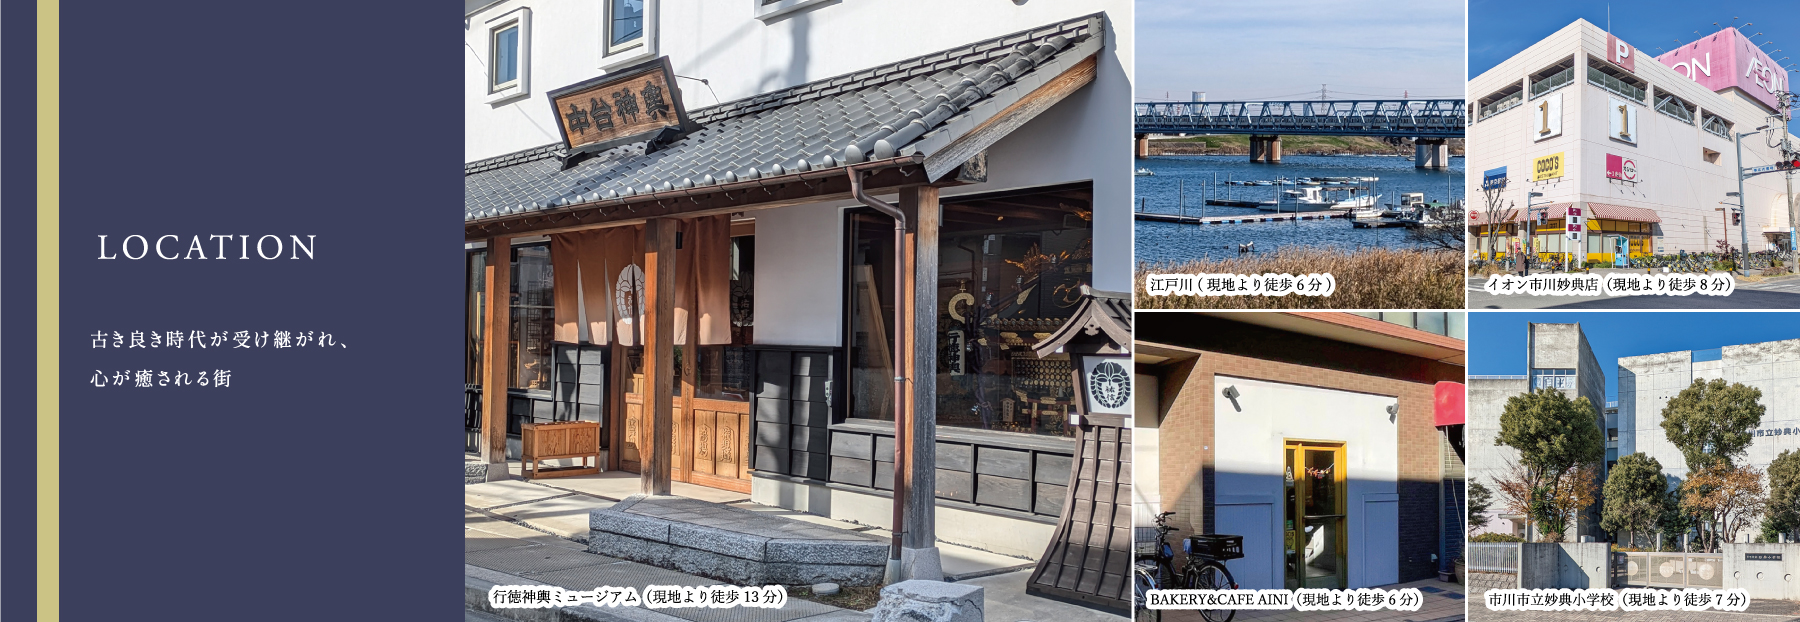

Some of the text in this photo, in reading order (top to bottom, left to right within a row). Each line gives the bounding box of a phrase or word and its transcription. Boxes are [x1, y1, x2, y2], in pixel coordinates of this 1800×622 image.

[1615, 39, 1629, 63] P
[1671, 52, 1711, 82] ON
[1539, 100, 1551, 134] 1
[1618, 104, 1631, 137] 1
[1537, 156, 1559, 174] COCO'S
